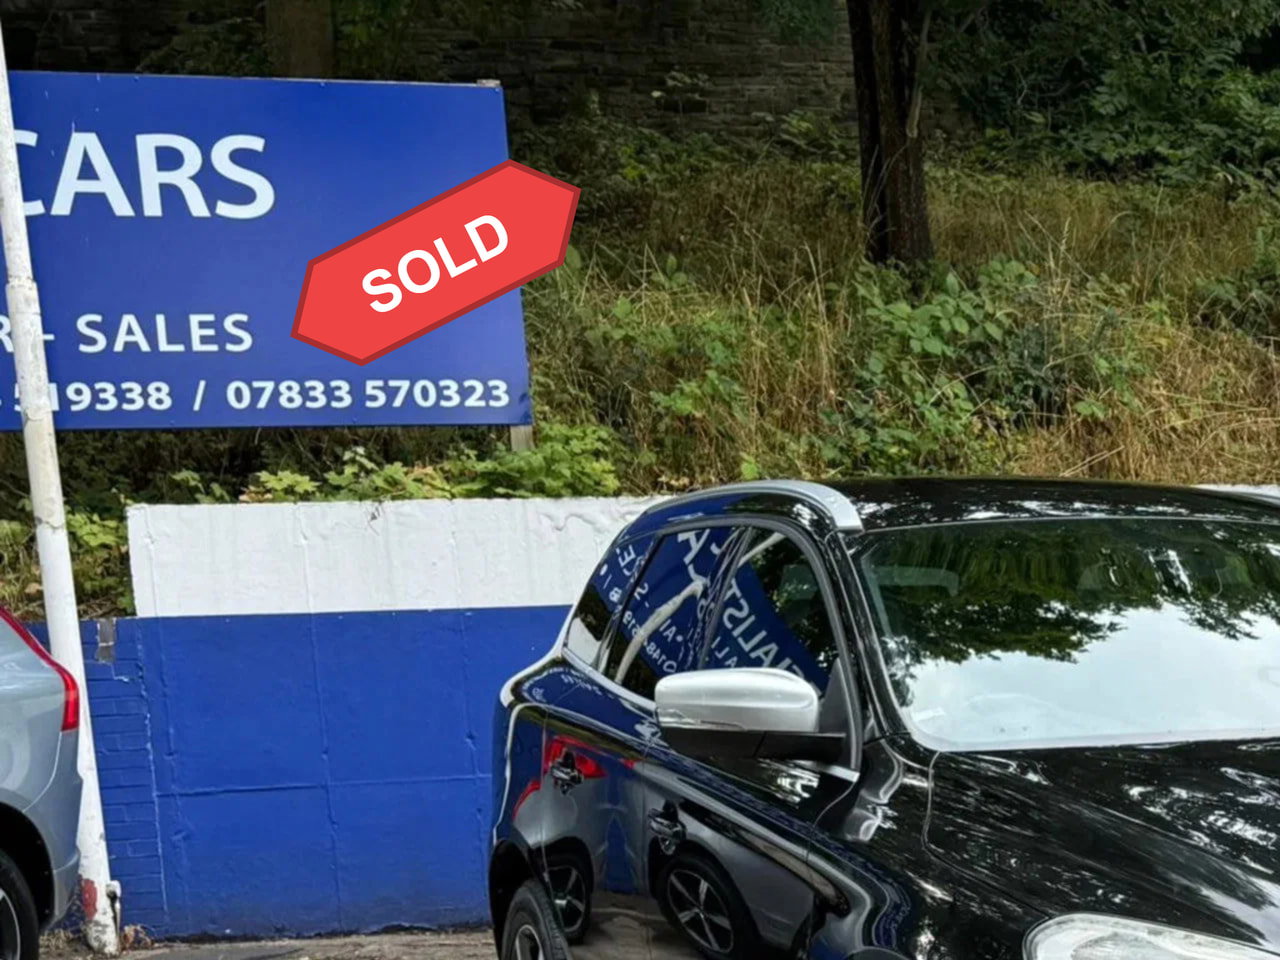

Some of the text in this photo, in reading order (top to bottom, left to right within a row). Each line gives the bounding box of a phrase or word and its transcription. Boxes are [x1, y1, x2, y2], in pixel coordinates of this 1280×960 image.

[76, 313, 253, 353] SALES
[226, 379, 352, 409] 07833
[365, 379, 510, 408] 570323
